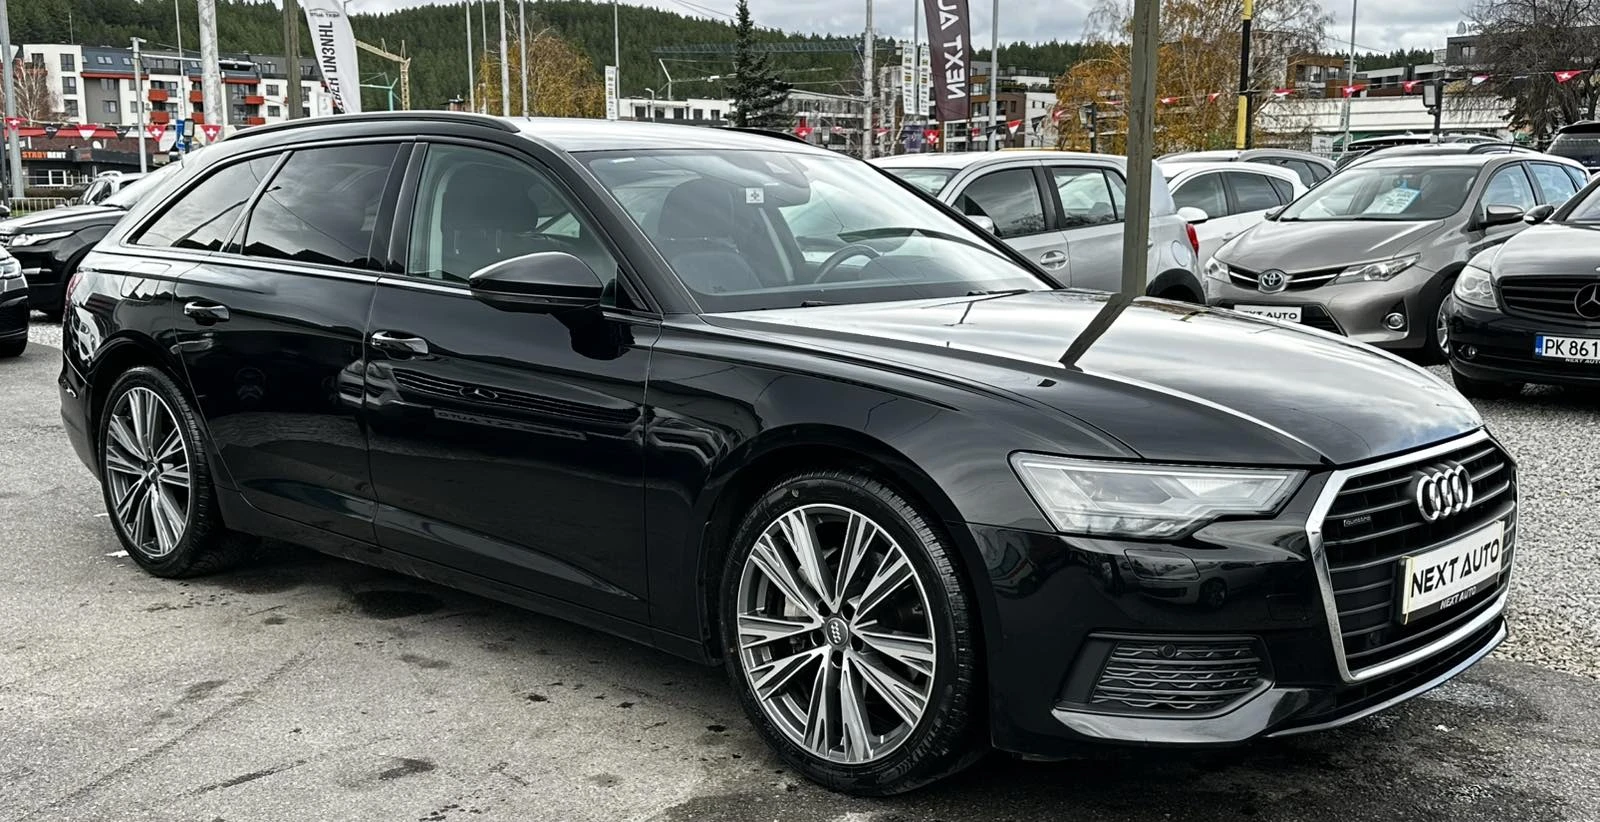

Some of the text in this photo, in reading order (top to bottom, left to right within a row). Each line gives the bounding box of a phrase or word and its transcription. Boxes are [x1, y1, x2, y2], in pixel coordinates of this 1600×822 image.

[1545, 339, 1565, 355] PK
[1410, 538, 1500, 598] NEXT AUTO
[1440, 586, 1478, 610] NEXT AUTO
